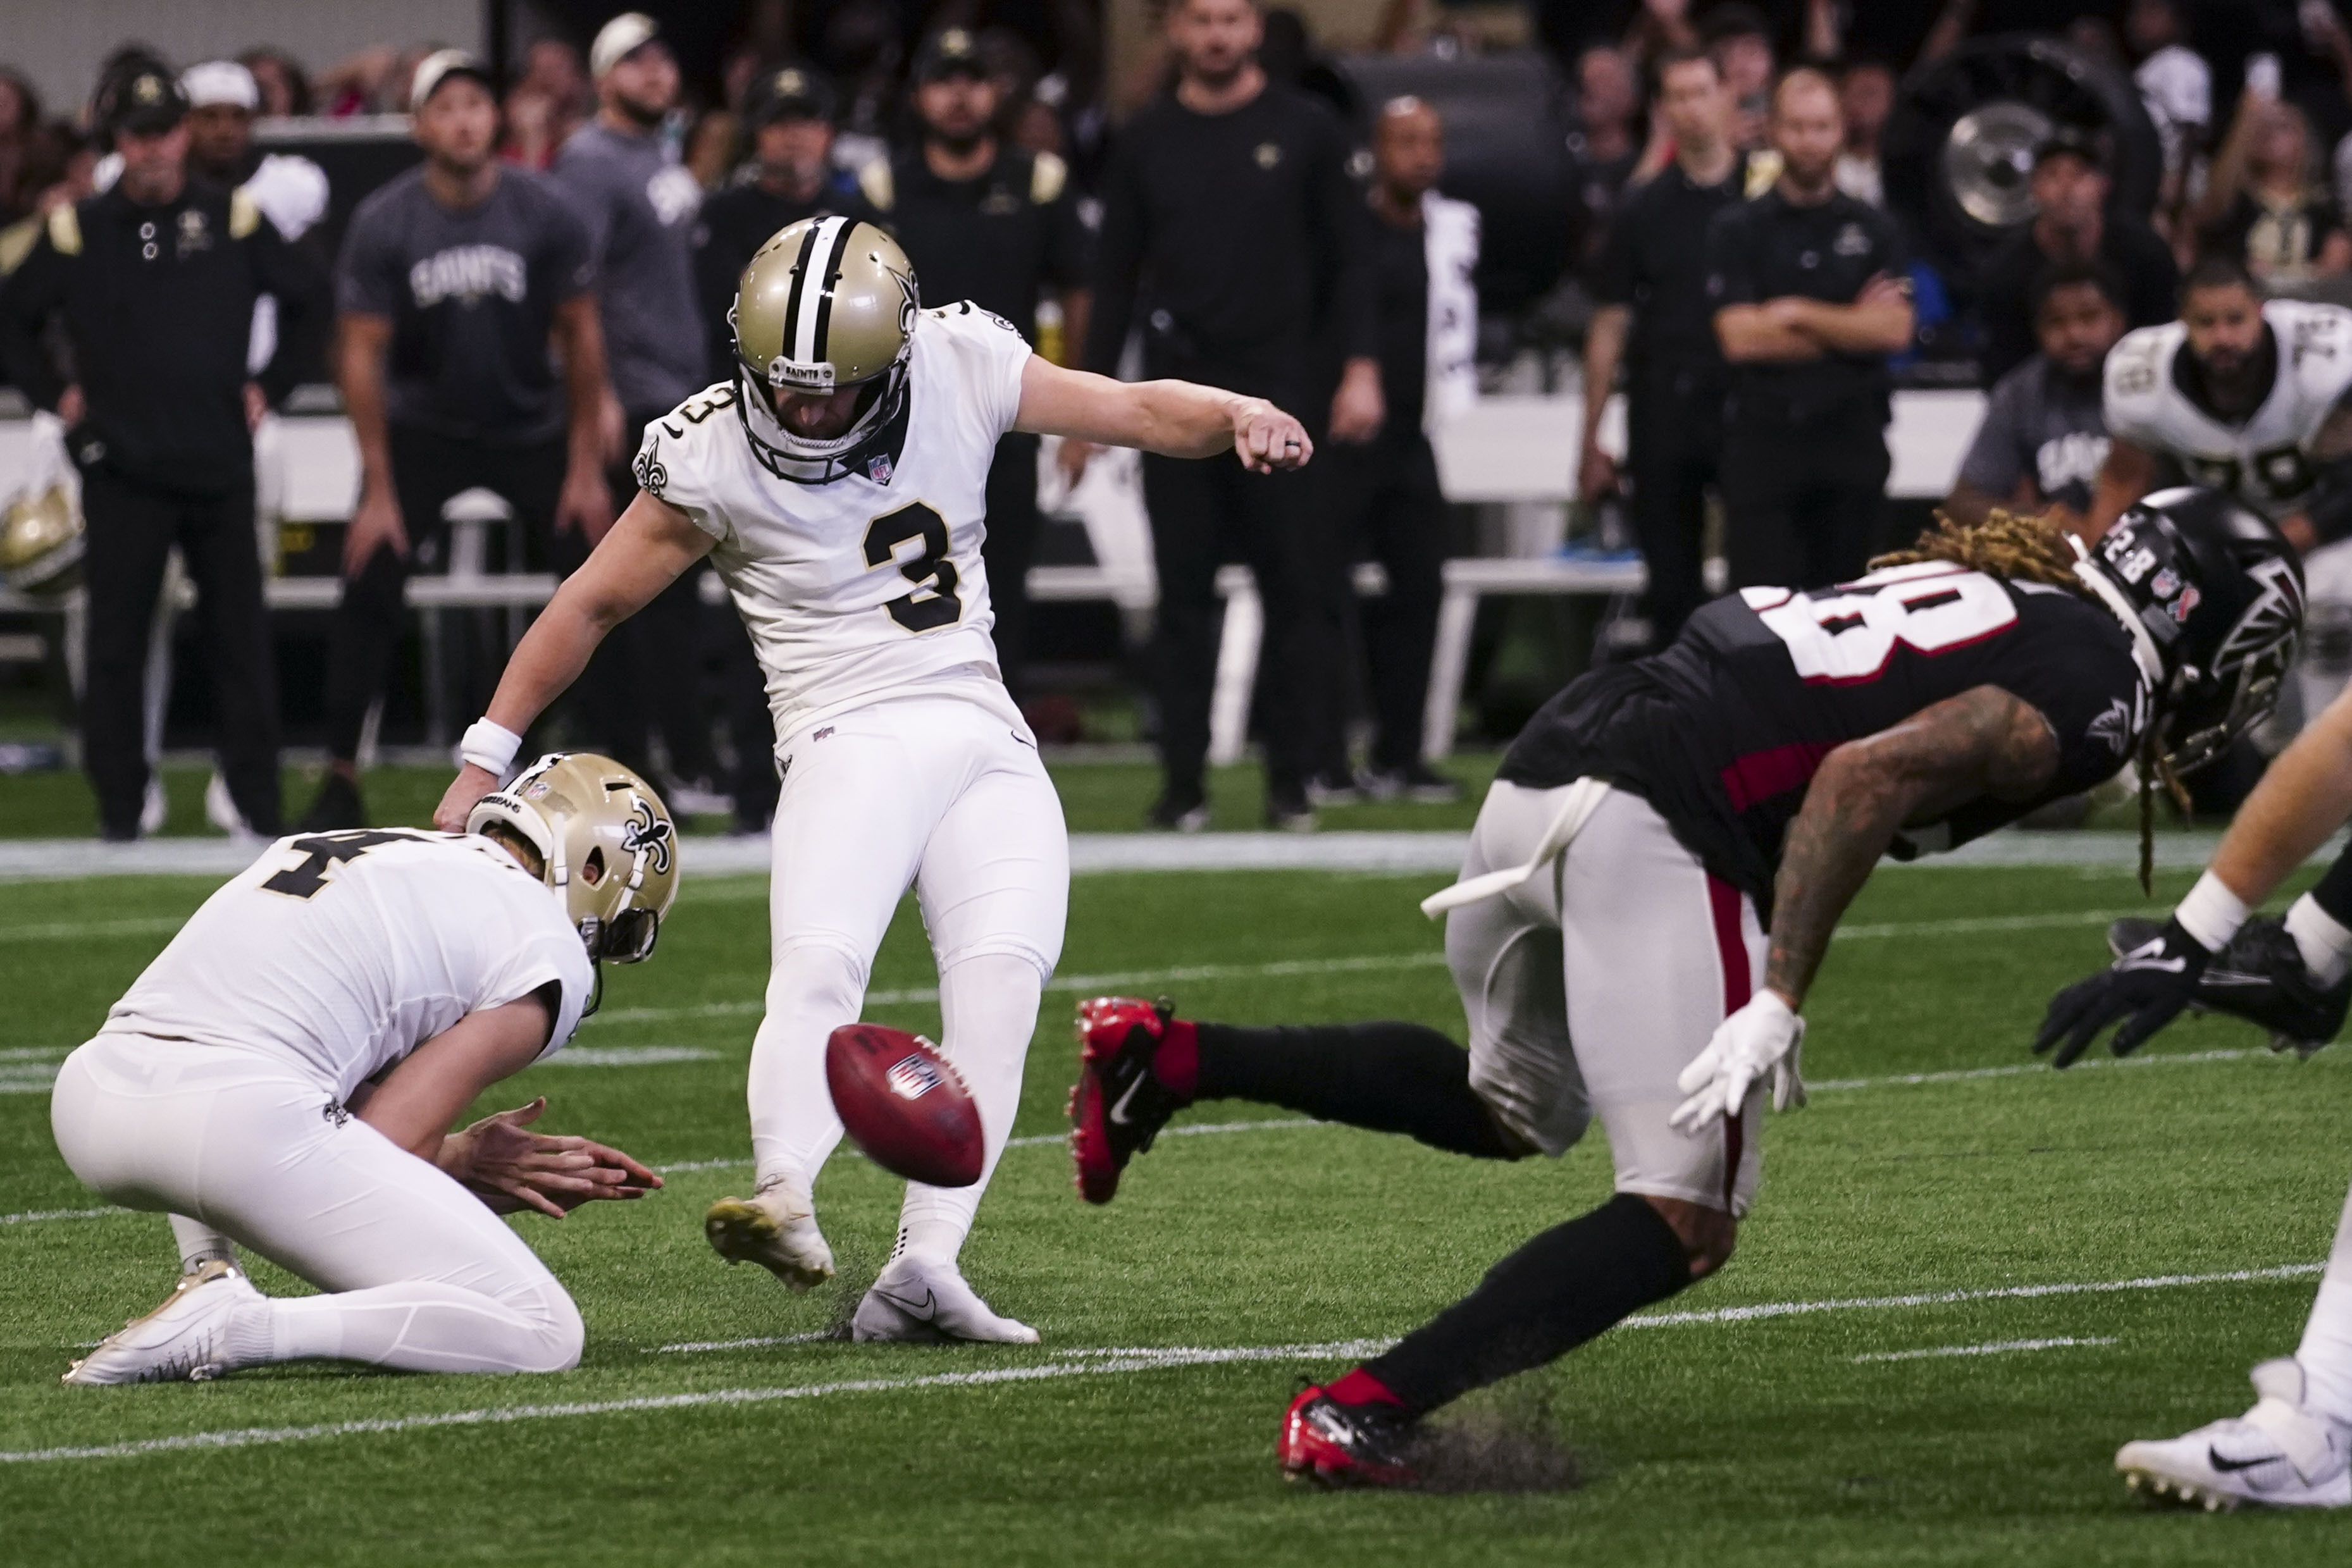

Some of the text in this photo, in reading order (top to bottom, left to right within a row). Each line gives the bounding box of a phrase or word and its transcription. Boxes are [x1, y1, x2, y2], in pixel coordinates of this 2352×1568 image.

[411, 244, 528, 307] SAINTS
[786, 366, 819, 380] SAINTS
[860, 497, 966, 636] 3
[2104, 526, 2157, 586] 28
